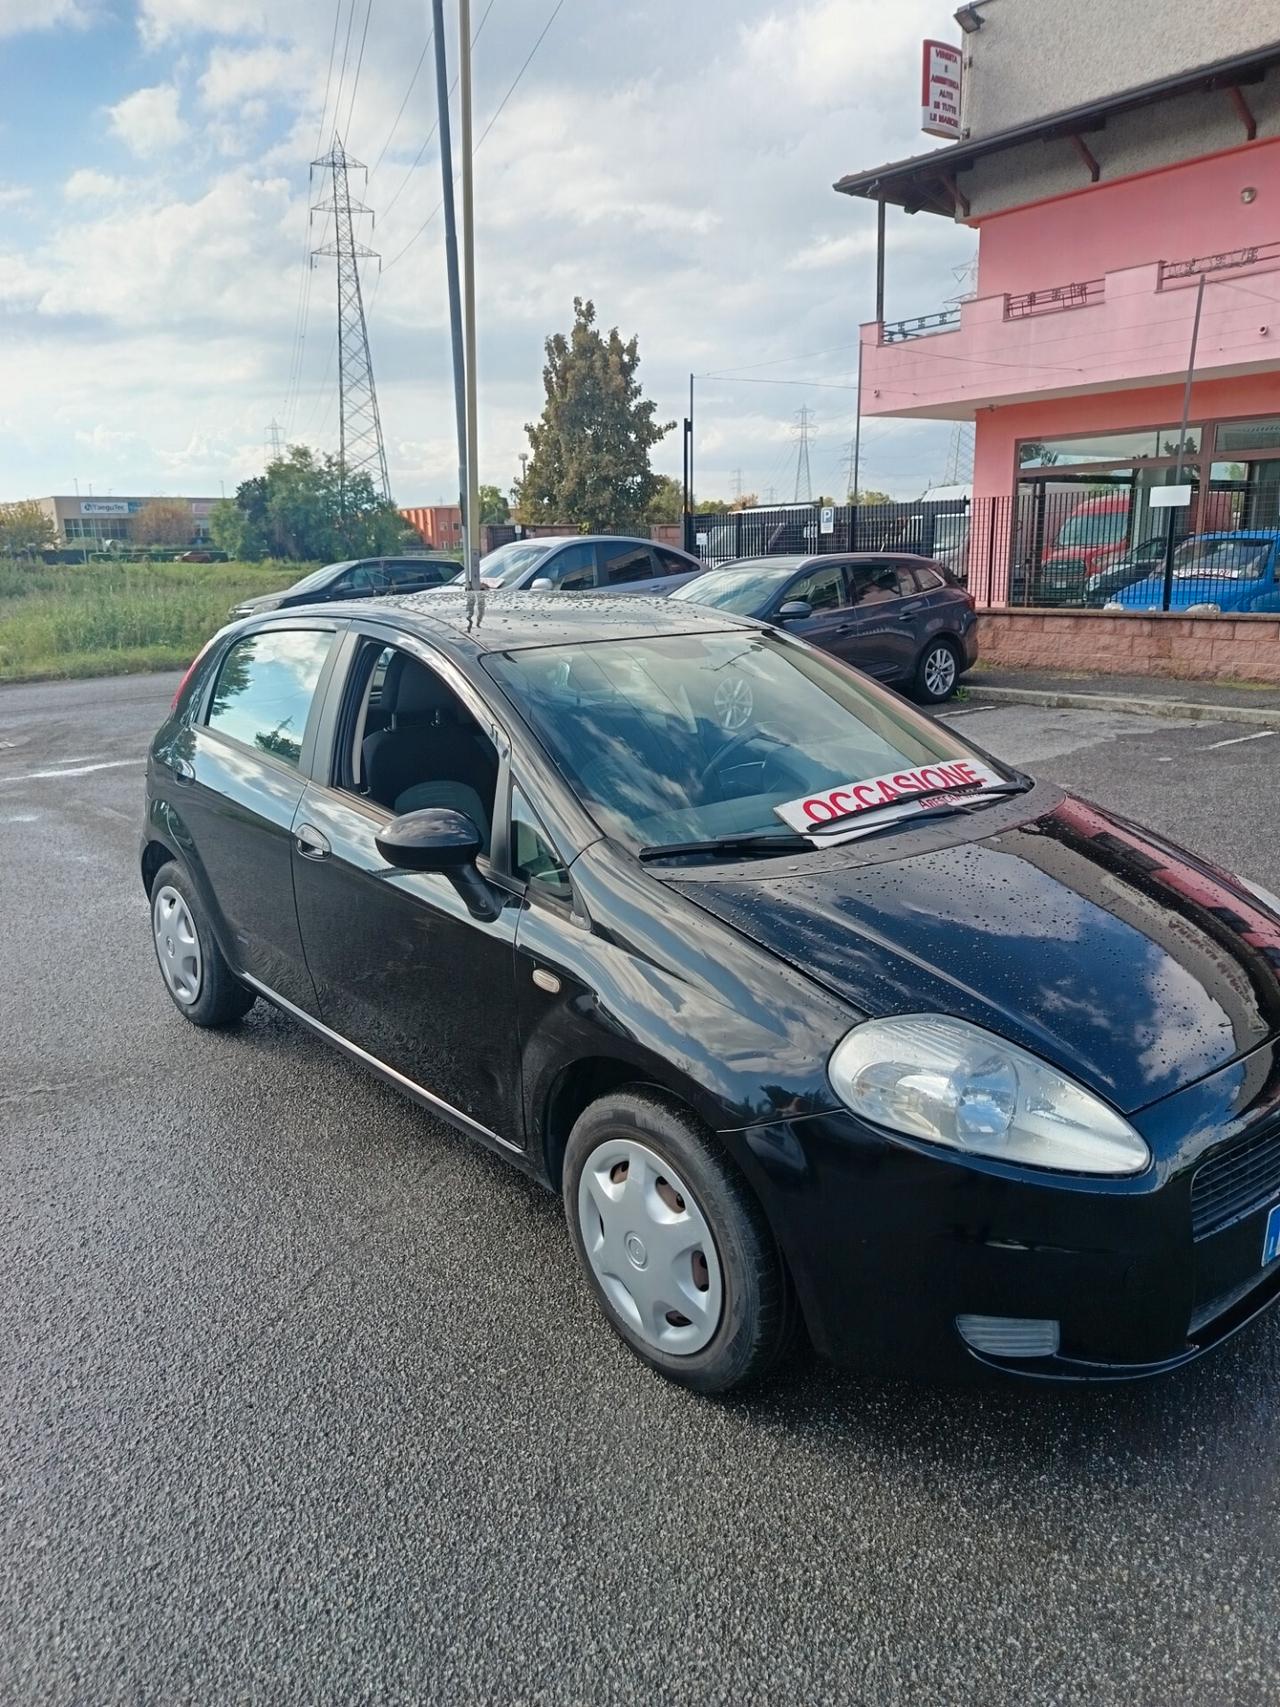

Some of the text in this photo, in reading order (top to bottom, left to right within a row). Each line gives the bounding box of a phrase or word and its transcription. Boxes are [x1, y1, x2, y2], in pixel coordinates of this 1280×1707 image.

[935, 49, 957, 64] VENDITA
[939, 89, 954, 101] AUTO
[942, 101, 957, 115] TUTTE
[929, 113, 937, 122] LE
[94, 503, 124, 512] TaeguTec
[823, 510, 831, 522] P
[803, 763, 987, 822] OCCASIONE
